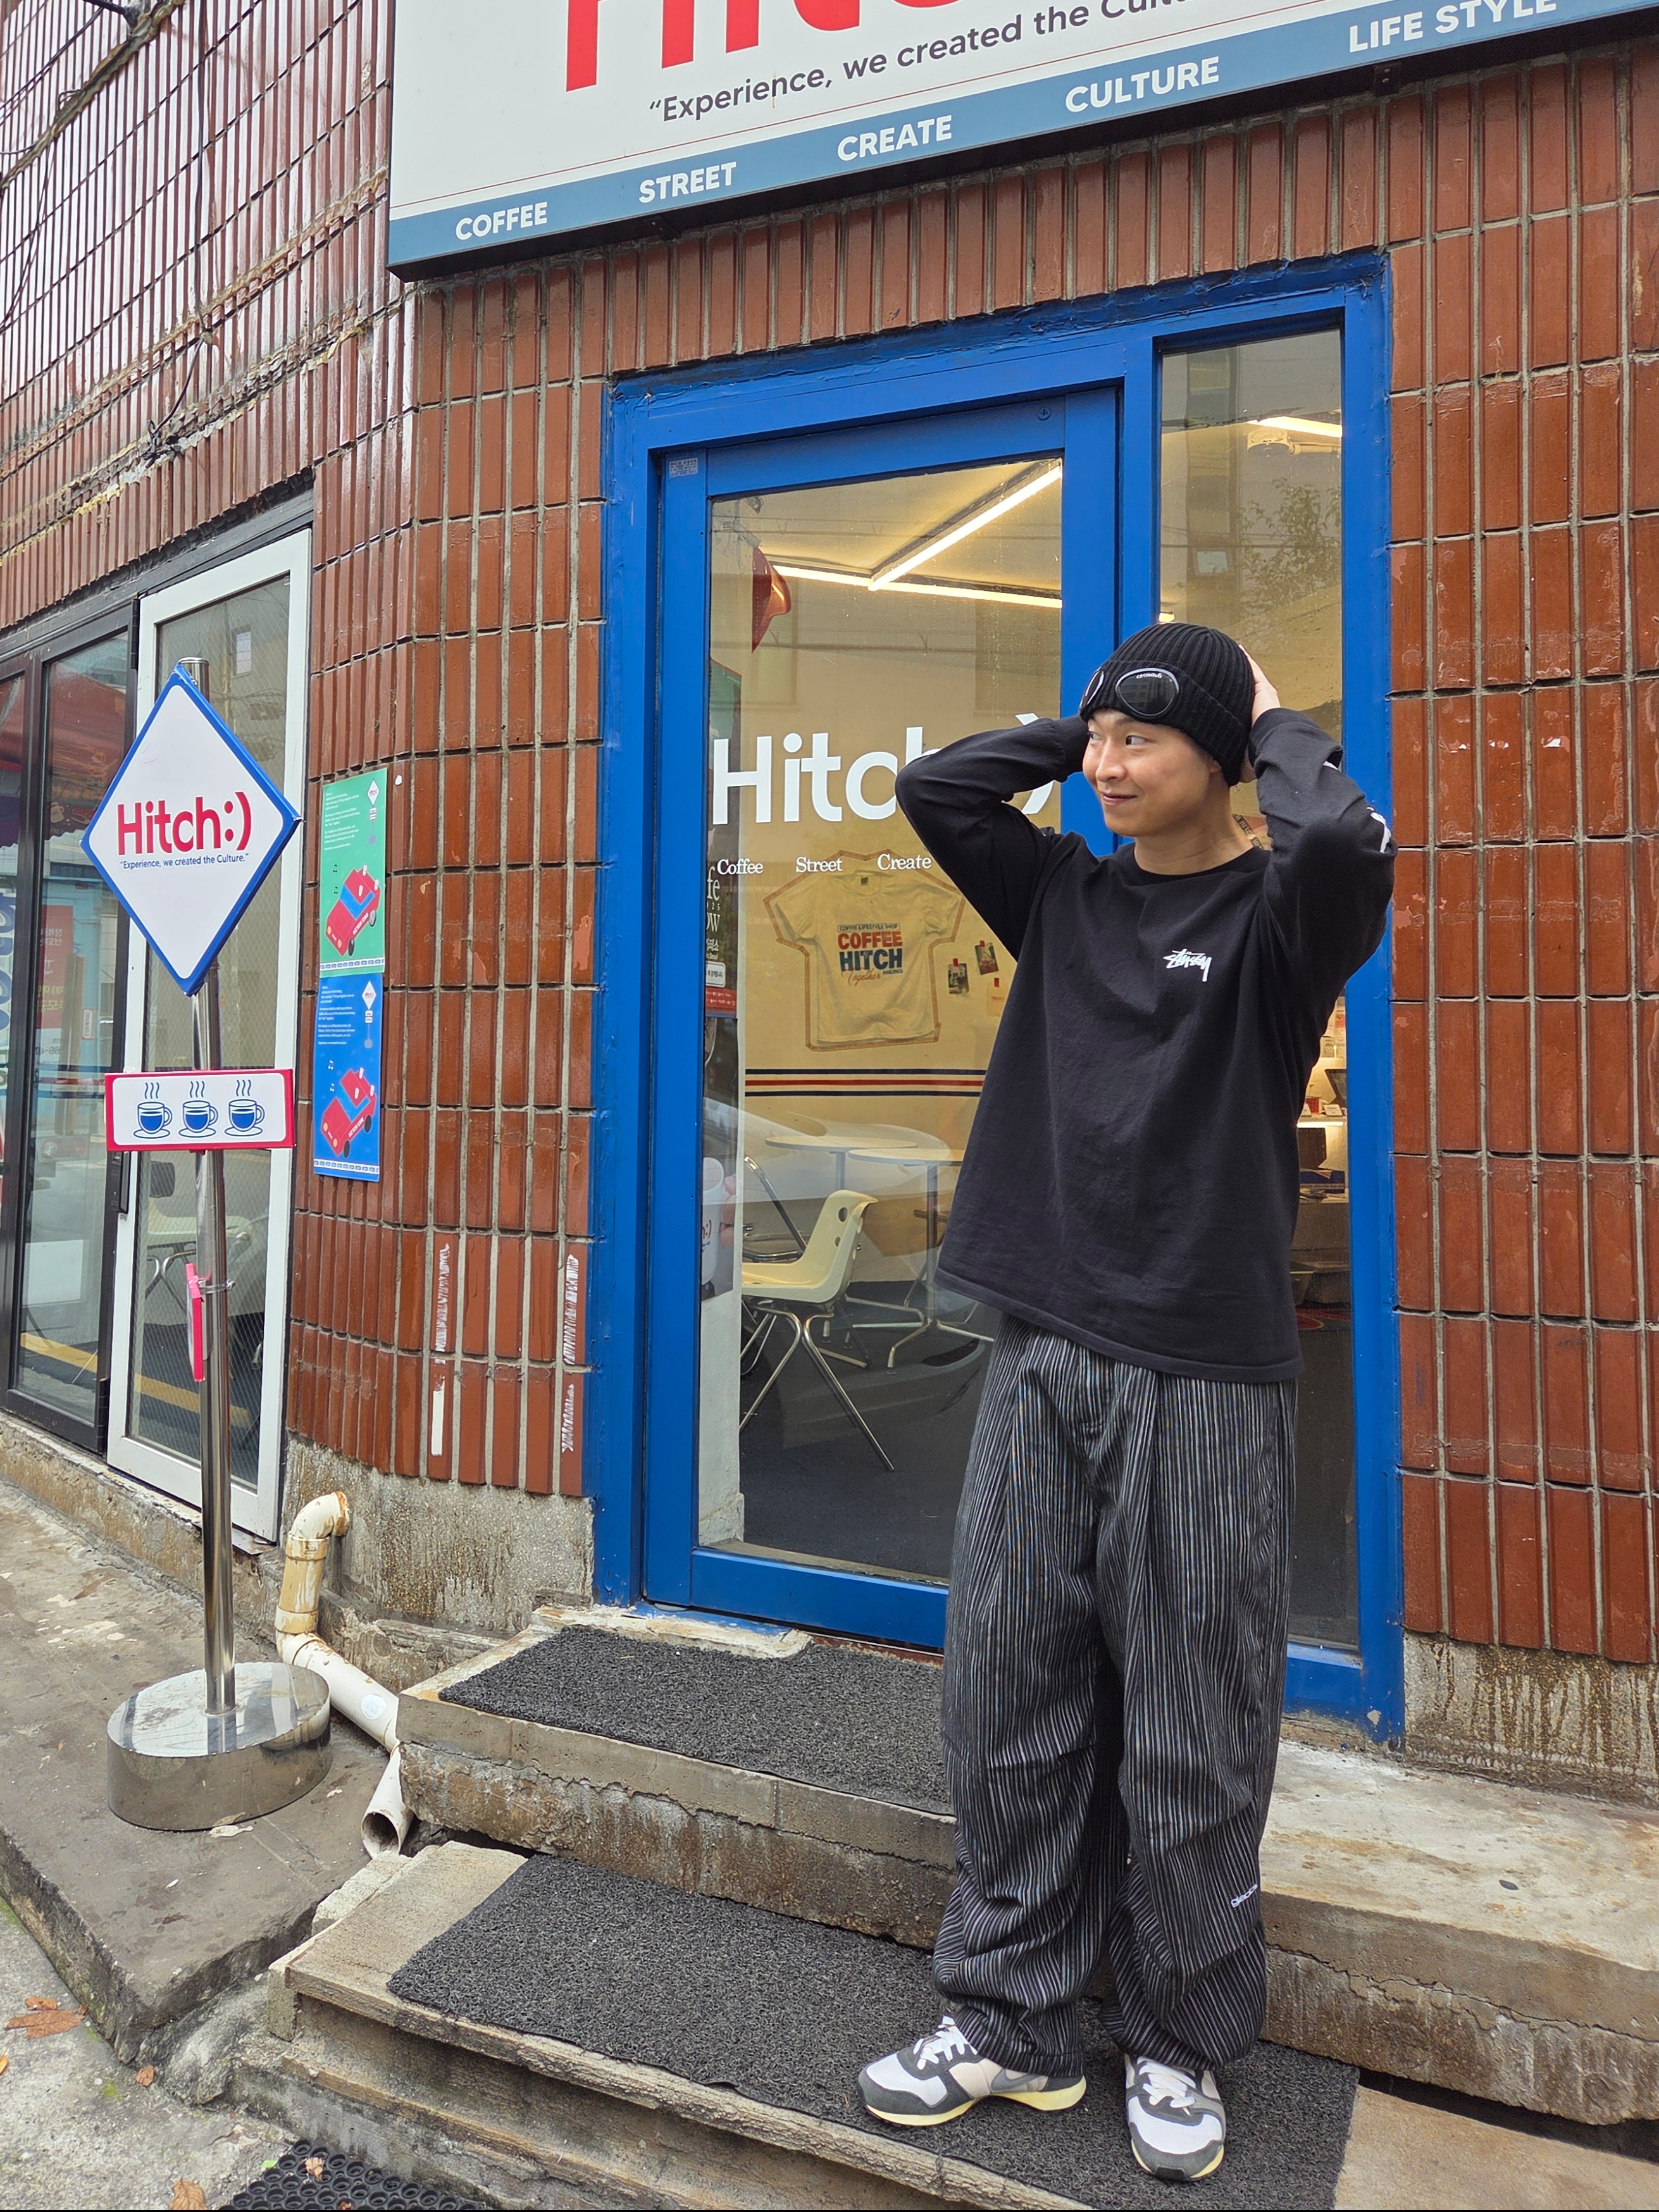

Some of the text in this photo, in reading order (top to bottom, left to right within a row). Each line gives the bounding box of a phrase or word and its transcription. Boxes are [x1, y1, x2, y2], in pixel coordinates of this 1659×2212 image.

[842, 53, 887, 80] we
[897, 15, 1021, 68] created
[1033, 6, 1089, 35] the
[455, 201, 548, 242] COFFEE
[638, 161, 737, 204] STREET
[837, 115, 952, 162] CREATE
[1065, 56, 1219, 113] CULTURE
[1350, 11, 1423, 53] LIFE
[117, 792, 252, 855] Hitch:)
[175, 856, 201, 866] created
[203, 855, 215, 864] the
[717, 854, 931, 875] Coffee Street Create
[838, 931, 903, 950] COFFEE
[839, 948, 902, 971] HITCH
